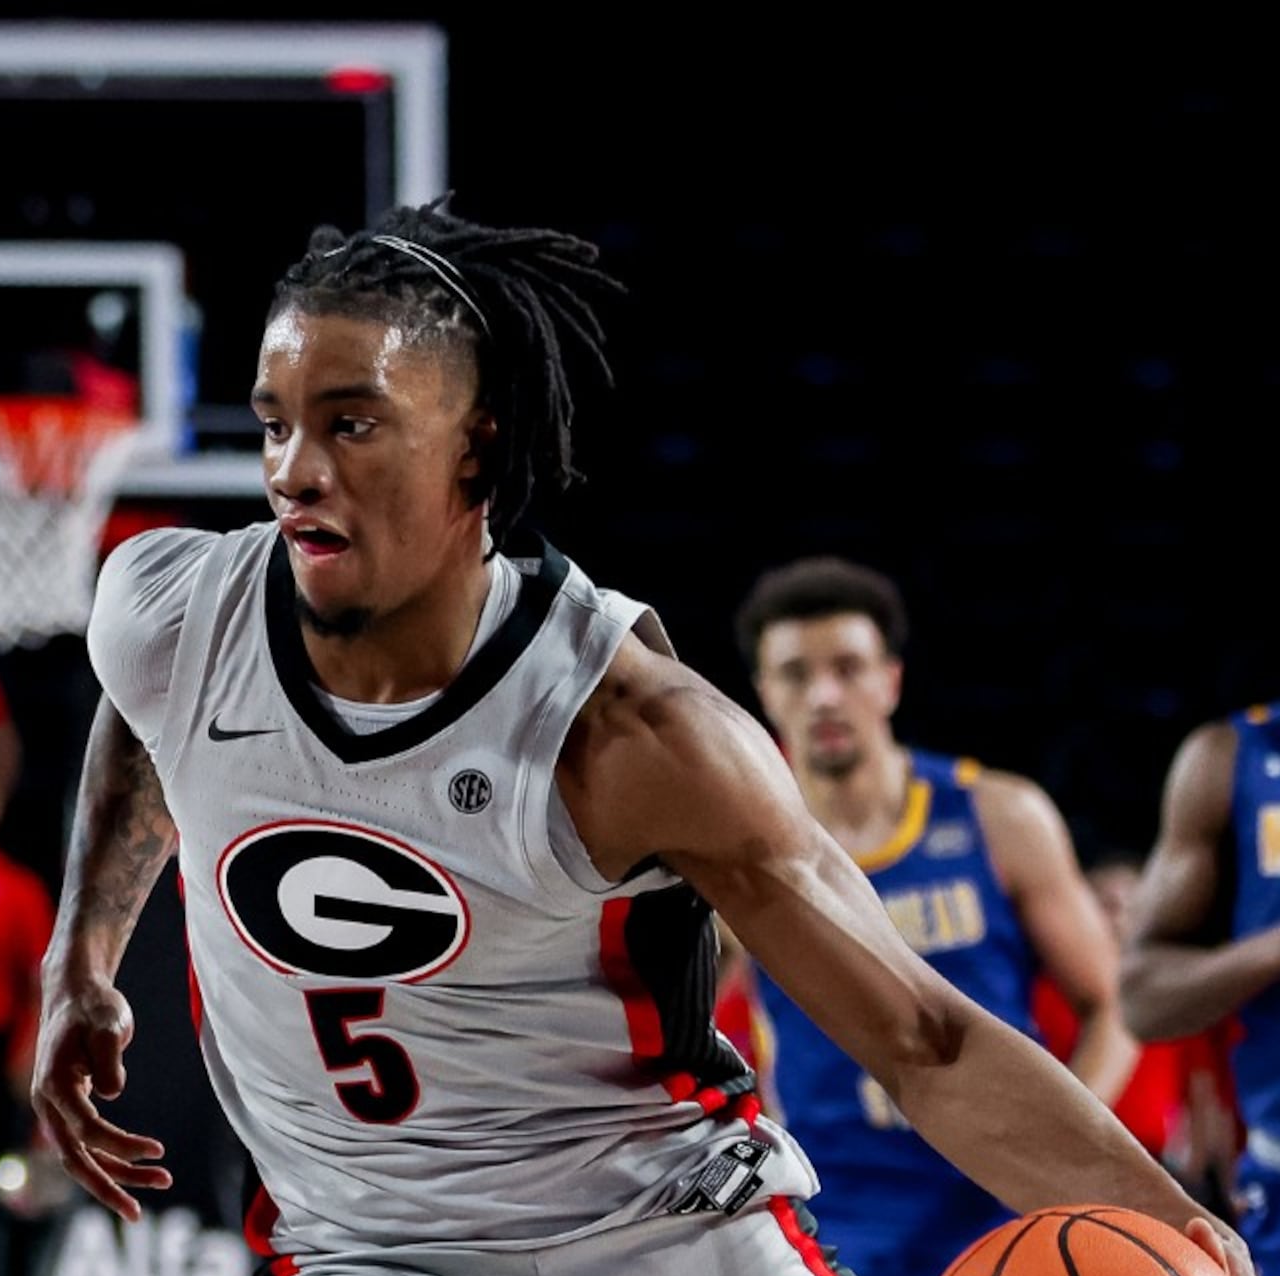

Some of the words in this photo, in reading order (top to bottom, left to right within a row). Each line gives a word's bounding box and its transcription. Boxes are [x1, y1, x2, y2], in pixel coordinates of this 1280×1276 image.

[454, 773, 490, 810] SEC
[220, 824, 465, 982] G
[302, 986, 422, 1126] 5
